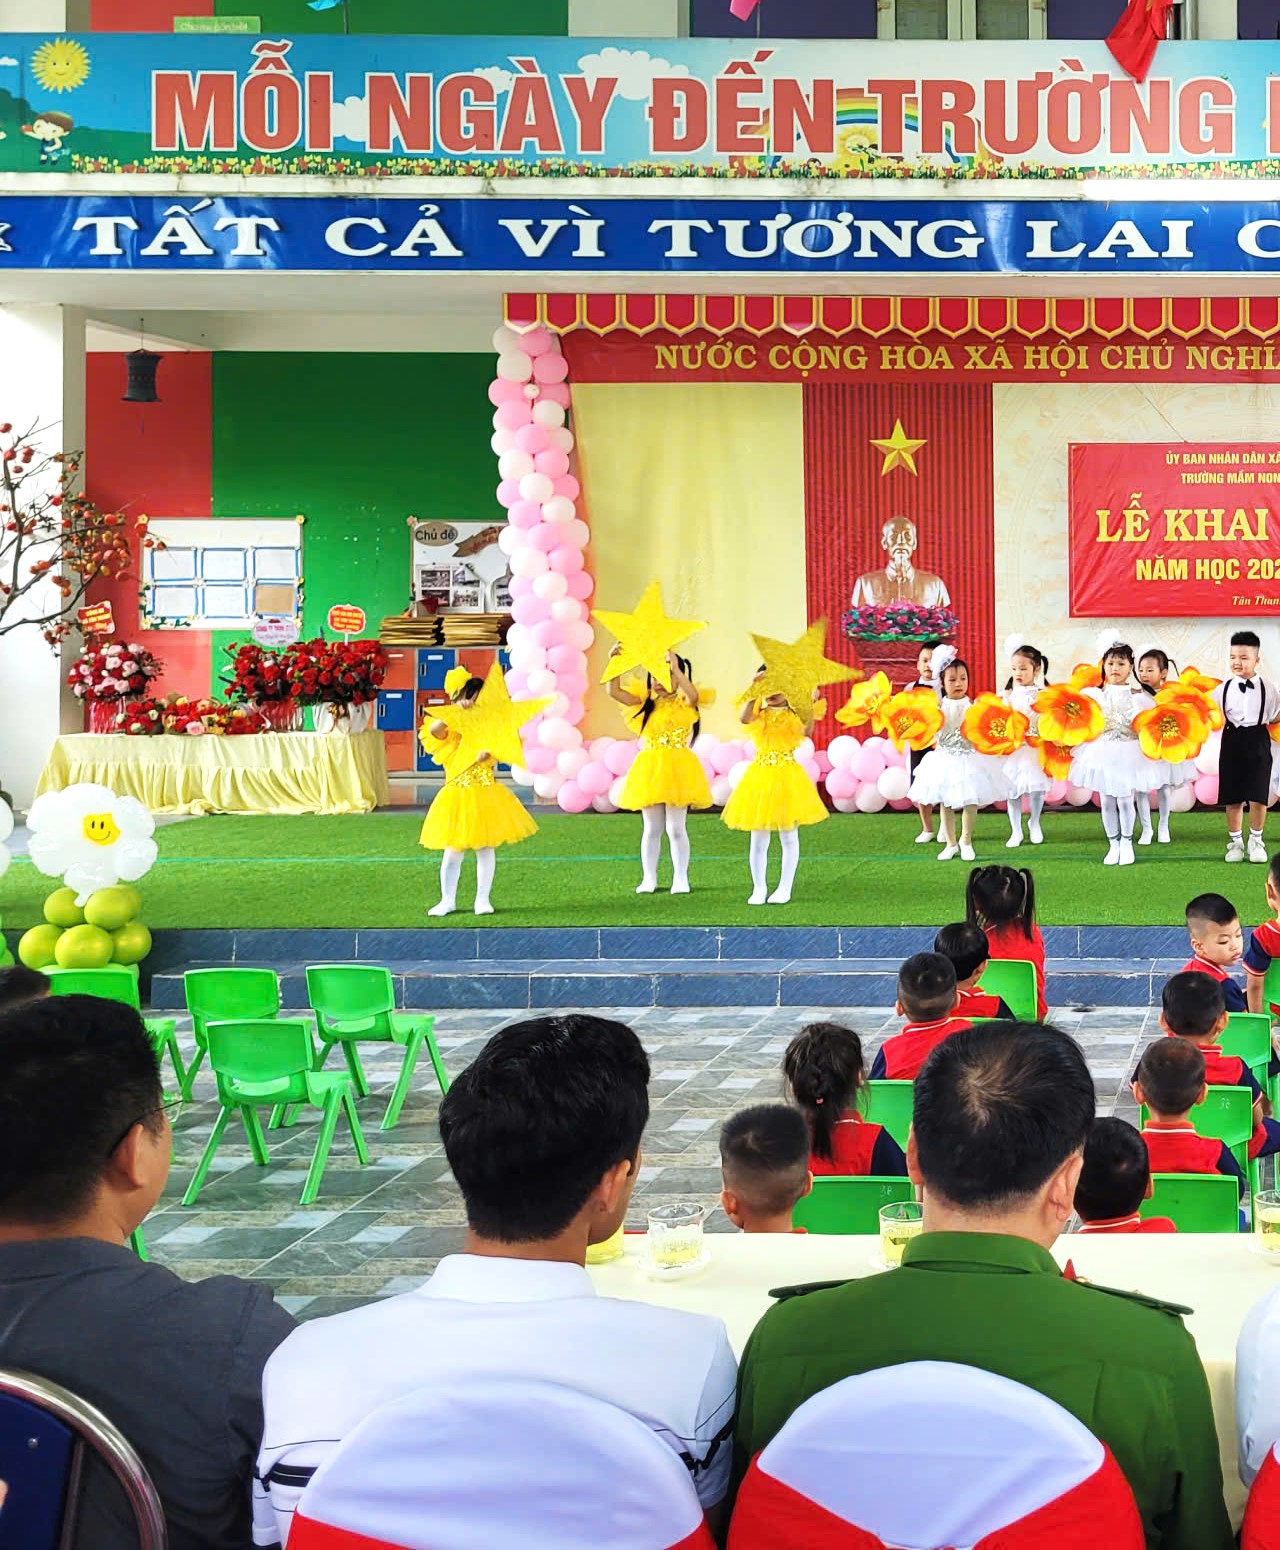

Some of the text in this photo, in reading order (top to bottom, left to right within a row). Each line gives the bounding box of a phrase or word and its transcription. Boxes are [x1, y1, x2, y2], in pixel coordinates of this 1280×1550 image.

[152, 40, 333, 153] MỖI
[365, 57, 621, 155] NGÀY
[646, 49, 837, 155] ĐẾN
[864, 57, 1236, 156] TRƯỜNG
[72, 199, 281, 256] TẤT
[325, 203, 463, 258] CẢ
[499, 204, 606, 258] VÌ
[647, 212, 985, 258] TƯƠNG
[1026, 219, 1194, 259] LAI
[654, 337, 758, 370] NƯỚC
[768, 339, 869, 377] CỘNG
[879, 338, 955, 370] HÒA
[963, 338, 1014, 370] XÃ
[1023, 339, 1090, 377] HỘI
[1100, 338, 1174, 370] CHỦ
[1183, 453, 1206, 464] BAN
[1209, 450, 1240, 464] NHÂN
[1242, 451, 1265, 464] DÂN
[1095, 492, 1151, 542] LỄ
[1163, 507, 1269, 542] KHAI
[1135, 555, 1188, 581] NĂM
[1195, 559, 1240, 584] HỌC
[1232, 595, 1251, 606] Tân
